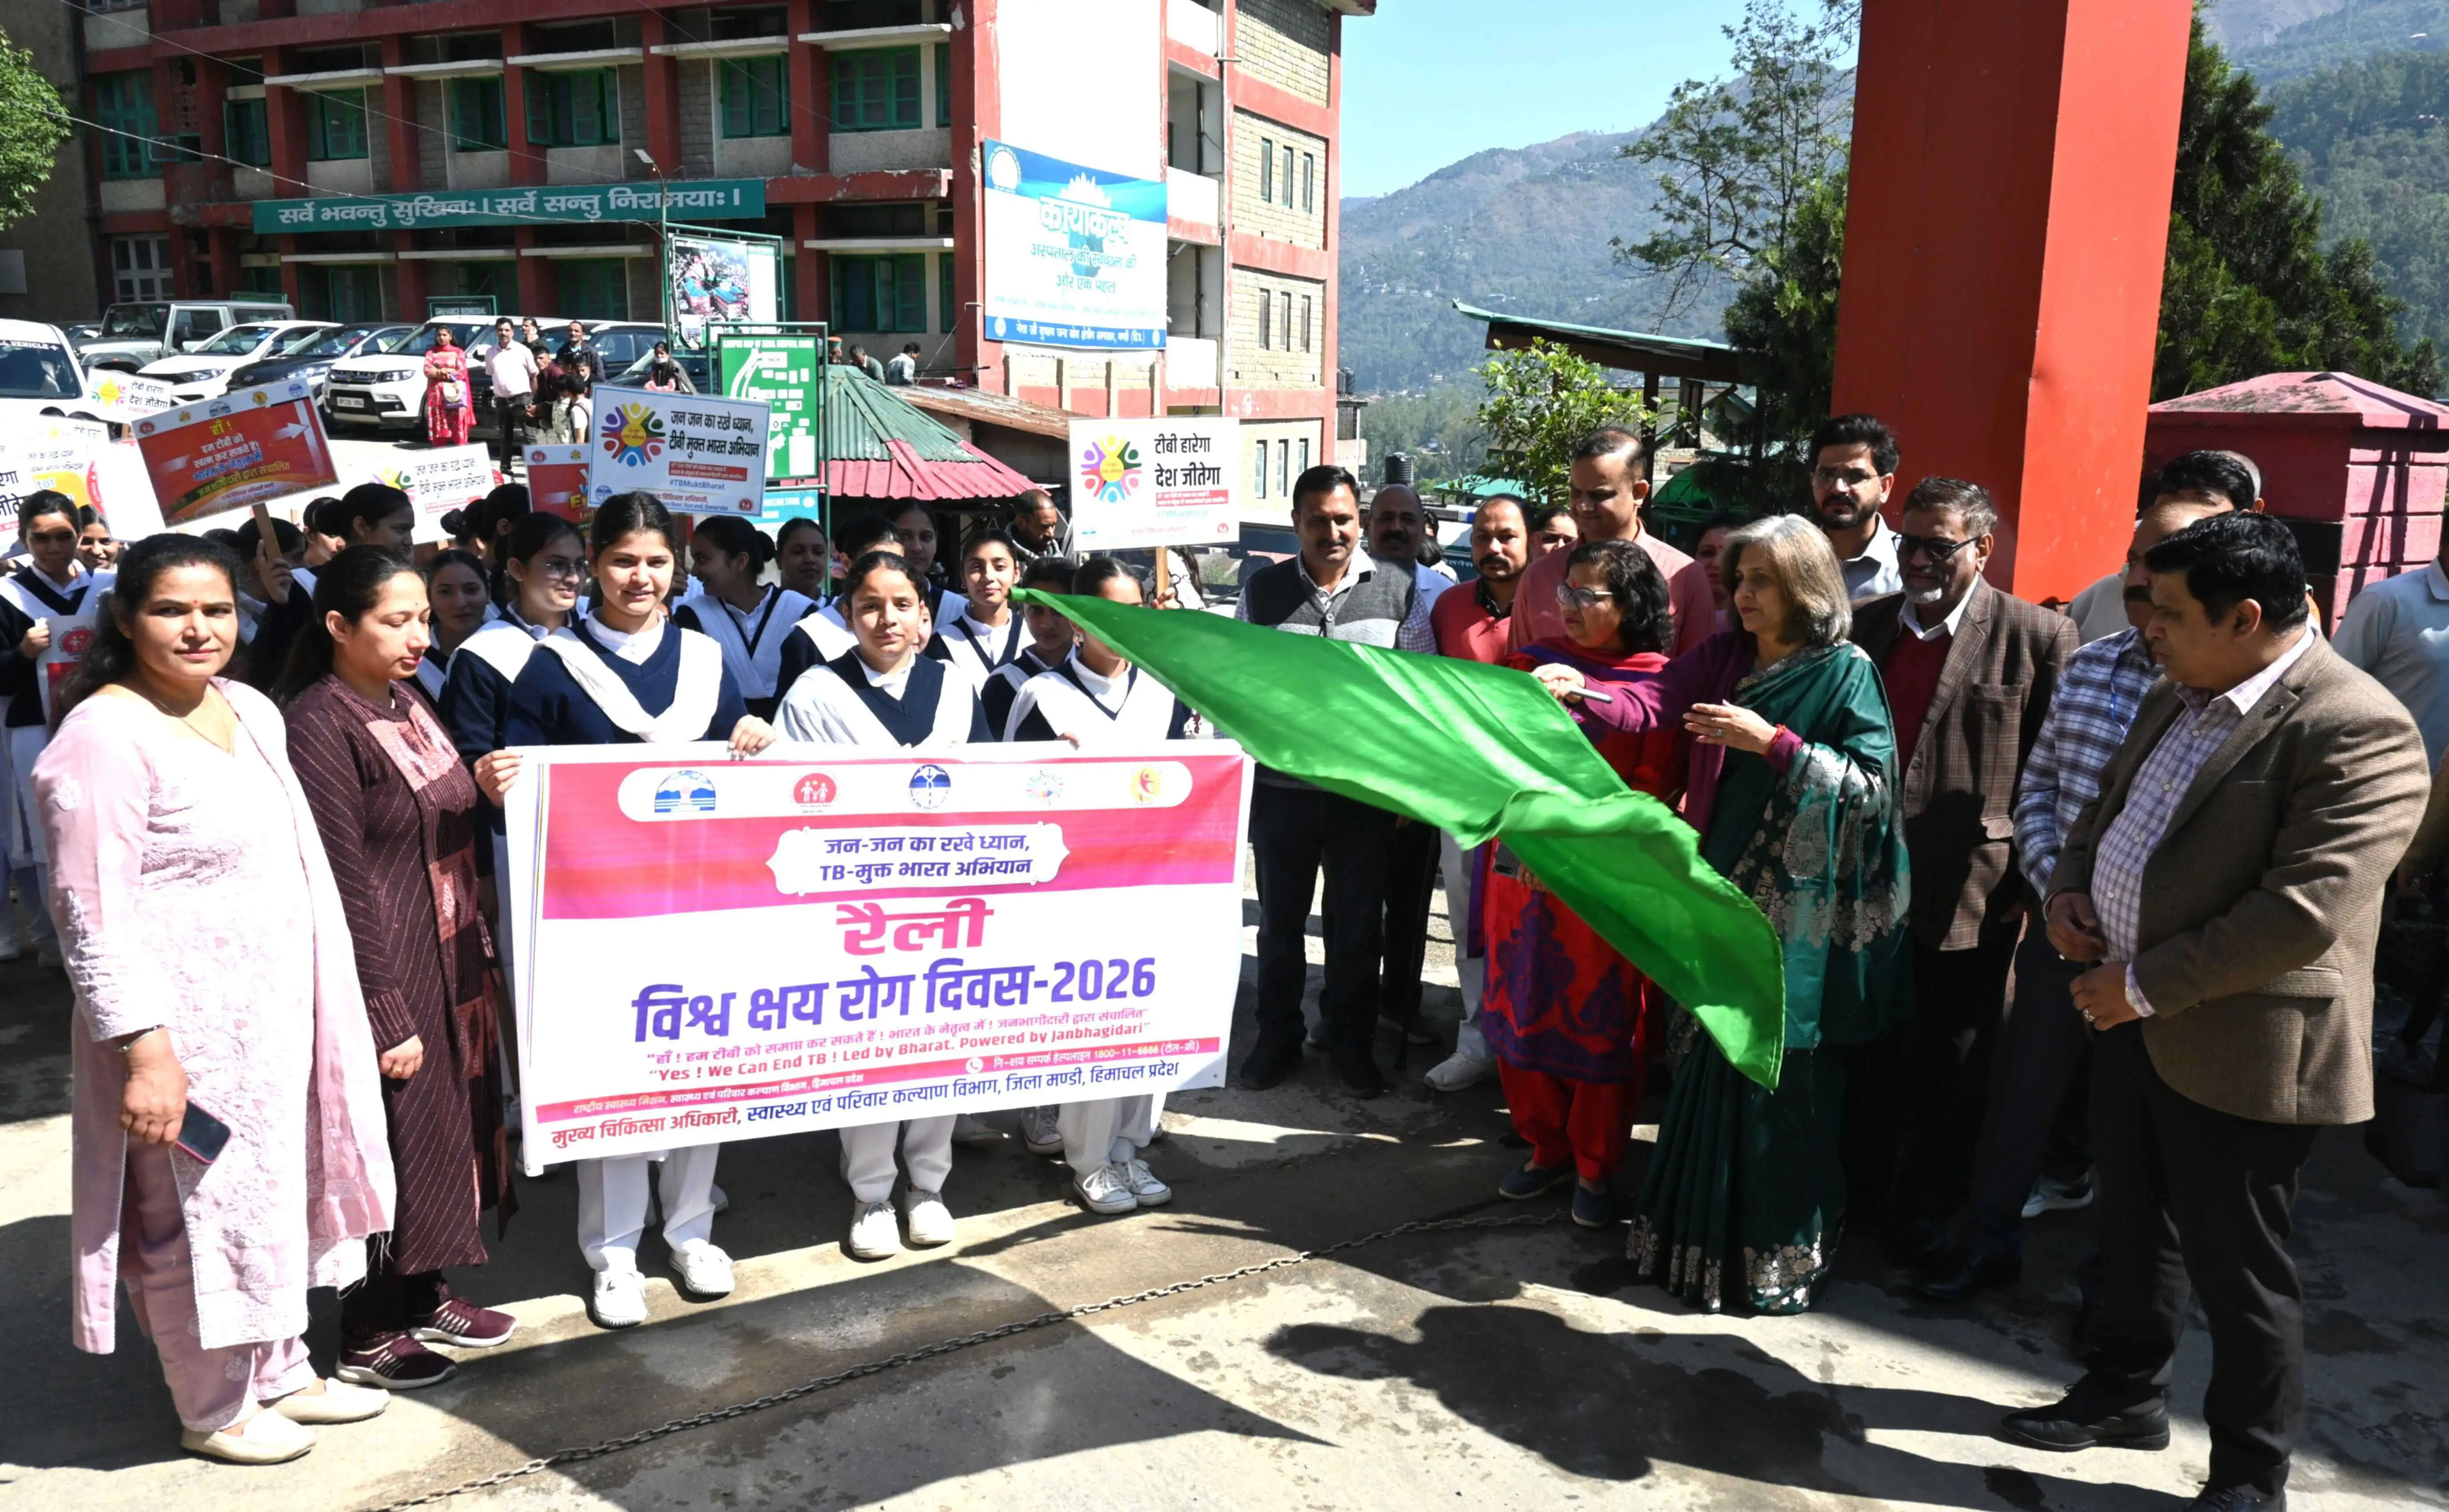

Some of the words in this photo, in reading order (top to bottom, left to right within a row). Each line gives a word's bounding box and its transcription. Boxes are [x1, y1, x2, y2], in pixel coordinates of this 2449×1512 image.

[278, 203, 315, 223] सर्वे
[321, 204, 387, 227] भवन्तु
[392, 195, 476, 225] सुखिनः
[495, 190, 537, 213] सर्वे
[543, 194, 601, 219] सन्तु
[609, 187, 725, 210] निरामयाः
[1030, 243, 1074, 262] अस्पताल
[1076, 246, 1090, 264] की
[1125, 254, 1137, 268] की
[1077, 277, 1092, 289] एक
[1096, 280, 1116, 293] पहल
[11, 341, 49, 350] VEHICLE
[145, 396, 168, 409] जीतेगा
[670, 411, 686, 425] जन
[688, 412, 703, 427] जन
[704, 414, 716, 428] का
[717, 411, 731, 431] रखे
[733, 417, 754, 434] ध्यान,
[669, 429, 685, 451] टीबी
[686, 437, 706, 459] मुक्त
[706, 439, 727, 454] भारत
[728, 435, 761, 458] अभियान
[1154, 433, 1178, 454] टीबी
[1180, 432, 1211, 453] हारेगा
[670, 479, 725, 490] #TBMuktBharat
[1154, 463, 1178, 487] देश
[1180, 462, 1221, 486] जीतेगा
[825, 837, 905, 854] जन-जन
[909, 837, 937, 851] का
[940, 832, 974, 852] रखे
[978, 834, 1030, 852] ध्यान,
[820, 862, 894, 884] TB-मुक्त
[898, 862, 951, 878] भारत
[955, 857, 1033, 876] अभियान
[836, 898, 994, 956] रैली
[631, 984, 738, 1043] विश्व
[747, 982, 829, 1031] क्षय
[837, 965, 916, 1021] रोग
[923, 957, 1157, 1014] दिवस-2026
[686, 1051, 709, 1062] हम
[713, 1046, 741, 1060] टीबी
[744, 1044, 761, 1057] को
[764, 1041, 804, 1054] समाप्त
[806, 1038, 827, 1048] कर
[830, 1031, 864, 1045] सकते
[866, 1030, 877, 1042] हैं
[888, 1029, 921, 1040] भारत
[924, 1024, 936, 1036] के
[938, 1022, 970, 1037] नेतृत्व
[973, 1019, 987, 1030] में
[997, 1013, 1069, 1029] जनभागीदारी
[1072, 1013, 1095, 1025] द्वारा
[708, 1065, 731, 1077] We
[738, 1062, 767, 1075] Can
[773, 1055, 802, 1071] End
[807, 1053, 826, 1066] TB
[843, 1048, 870, 1062] Led
[875, 1045, 894, 1058] by
[898, 1039, 954, 1055] Bharat.
[960, 1031, 1025, 1049] Powered
[1029, 1031, 1047, 1044] by
[1027, 1052, 1052, 1065] सम्पर्क
[1053, 1050, 1091, 1064] हेल्पलाइन
[1094, 1045, 1159, 1060] 1800-11-6666
[552, 1125, 594, 1148] मुख्य
[599, 1115, 666, 1139] चिकित्सा
[670, 1107, 742, 1129] अधिकारी,
[747, 1101, 806, 1122] स्वास्थ्य
[811, 1094, 833, 1113] एवं
[837, 1090, 889, 1110] परिवार
[893, 1085, 949, 1103] कल्याण
[953, 1078, 1001, 1097] विभाग,
[1006, 1073, 1041, 1092] जिला
[1046, 1067, 1085, 1087] मण्डी,
[1090, 1065, 1145, 1083] हिमाचल
[1148, 1060, 1180, 1077] प्रदेश
[574, 1100, 603, 1114] राष्ट्रीय
[605, 1098, 637, 1109] स्वास्थ्य
[638, 1093, 667, 1105] मिशन,
[670, 1092, 702, 1104] स्वास्थ्य
[702, 1089, 715, 1100] एवं
[717, 1086, 747, 1098] परिवार
[747, 1085, 779, 1097] कल्याण
[781, 1081, 810, 1093] विभाग,
[812, 1076, 845, 1089] हिमाचल
[845, 1073, 865, 1083] प्रदेश
